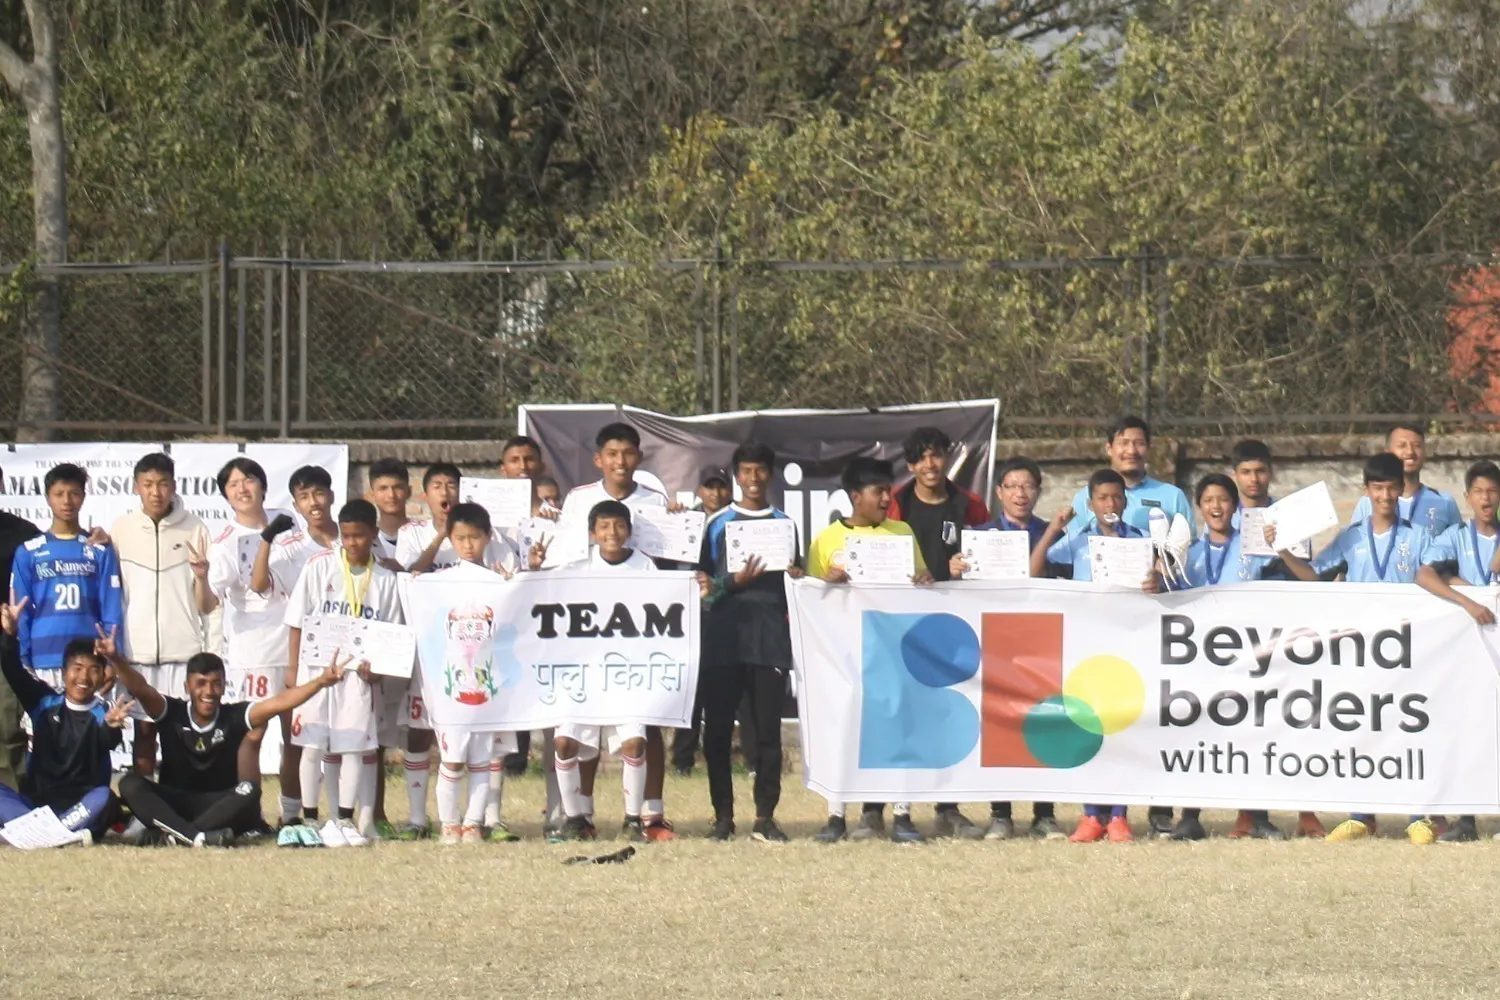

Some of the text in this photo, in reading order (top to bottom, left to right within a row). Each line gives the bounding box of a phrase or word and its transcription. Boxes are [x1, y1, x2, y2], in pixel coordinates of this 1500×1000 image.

[55, 583, 80, 610] 20
[531, 602, 685, 639] TEAM
[1159, 614, 1412, 678] Beyond
[246, 673, 269, 698] 18
[1158, 678, 1430, 733] borders
[1159, 741, 1425, 781] with football
